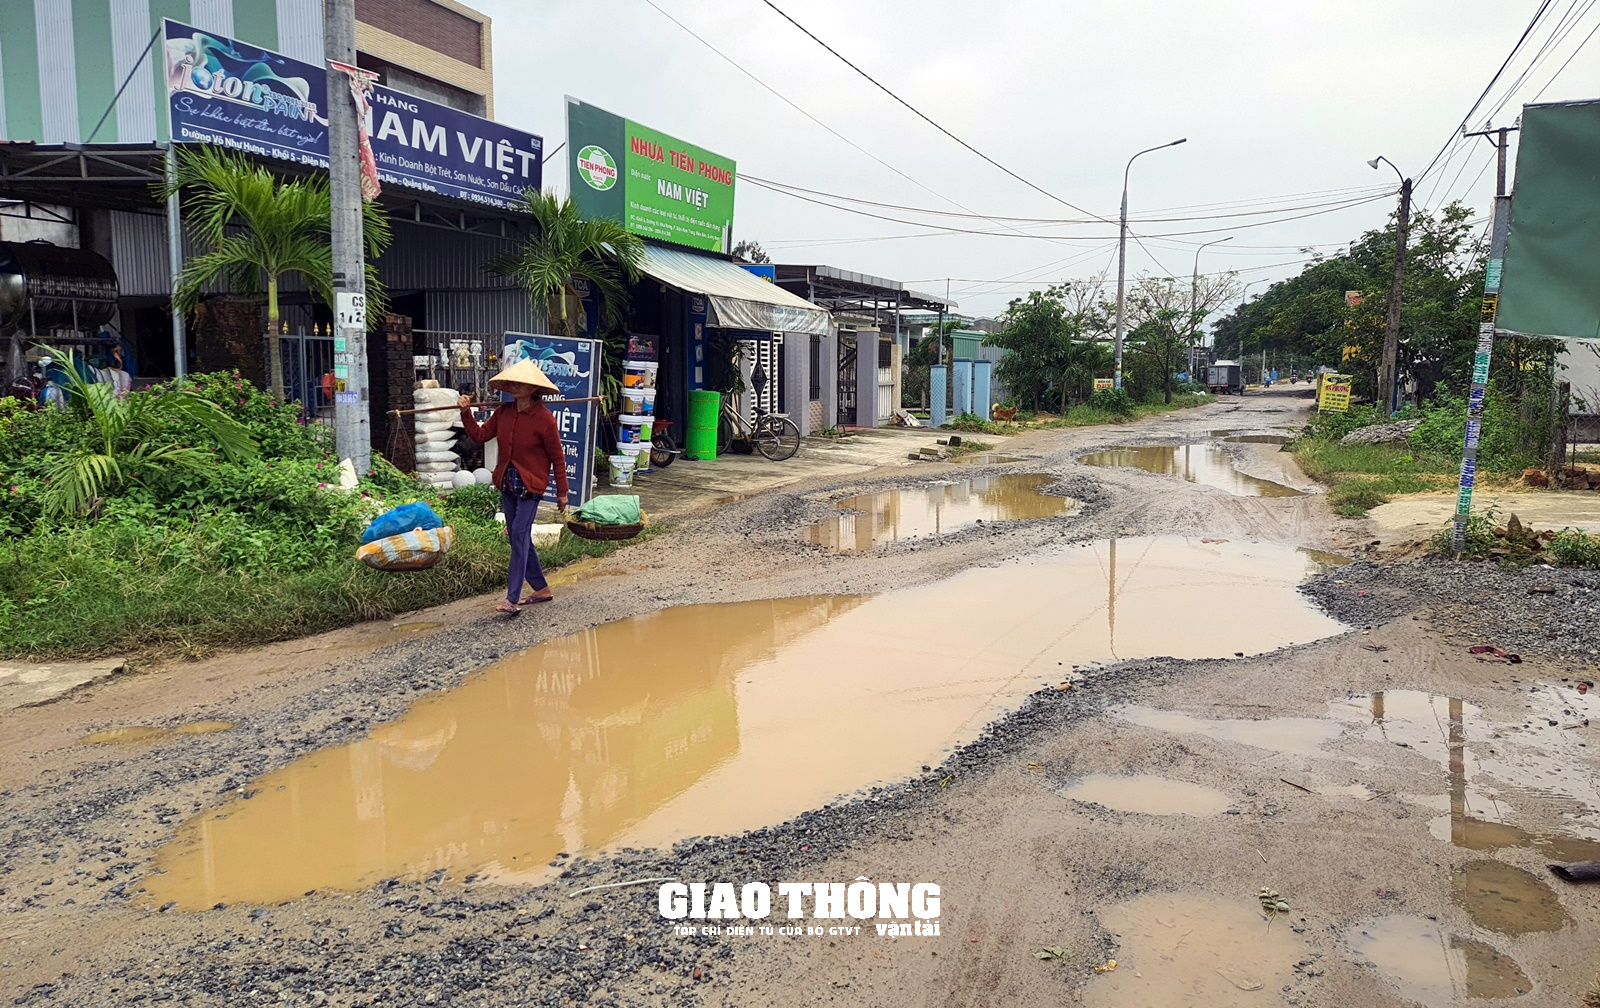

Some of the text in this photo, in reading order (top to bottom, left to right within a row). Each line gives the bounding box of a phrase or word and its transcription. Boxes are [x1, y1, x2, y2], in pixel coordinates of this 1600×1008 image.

[263, 95, 317, 123] PAINT
[376, 95, 419, 113] HÀNG
[181, 127, 211, 143] Đường
[225, 138, 244, 150] Như
[244, 142, 266, 156] Hưng
[456, 131, 536, 181] VIỆT
[379, 151, 397, 166] Kinh
[398, 156, 424, 172] Doanh
[424, 163, 438, 176] Bột
[453, 170, 467, 182] Sơn
[468, 173, 485, 187] Nước,
[486, 178, 499, 190] Sơn
[579, 159, 616, 178] TIEN PHONG
[630, 136, 665, 165] NHỰA
[699, 161, 733, 186] PHONG
[657, 179, 709, 211] NAM VIỆT
[573, 279, 589, 291] TOA
